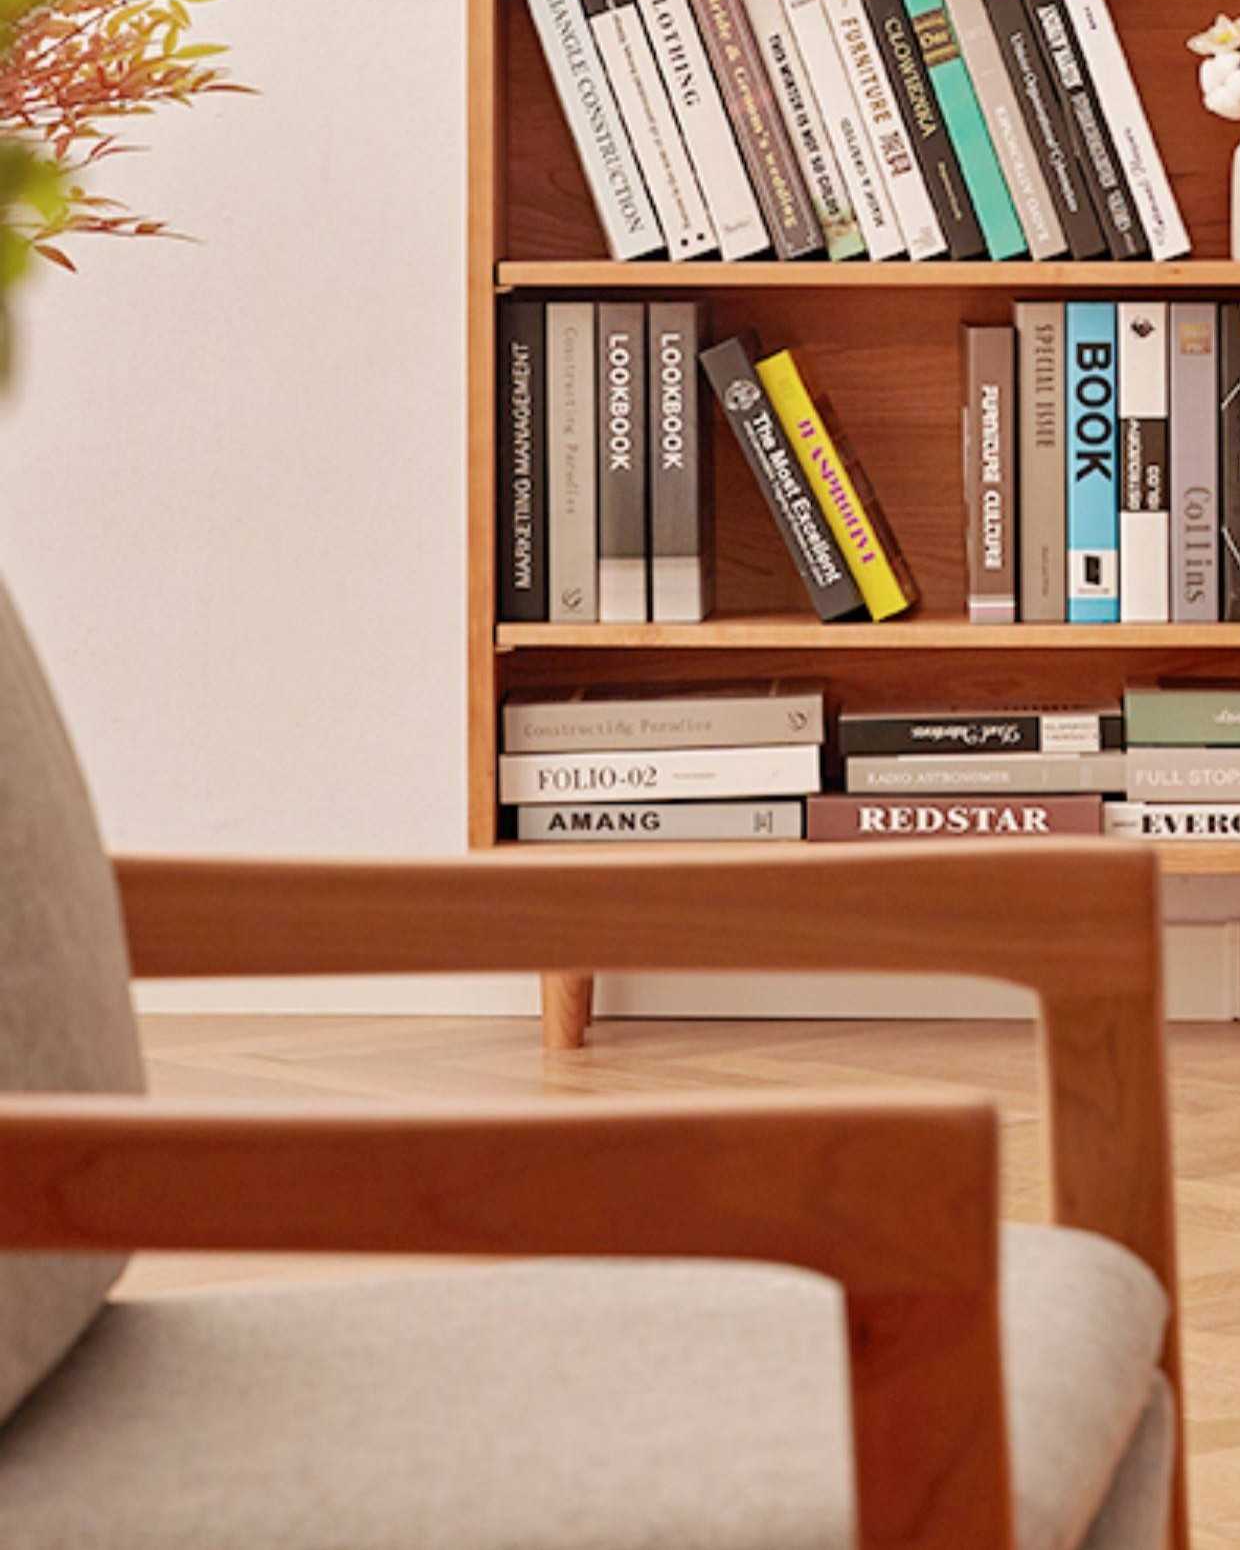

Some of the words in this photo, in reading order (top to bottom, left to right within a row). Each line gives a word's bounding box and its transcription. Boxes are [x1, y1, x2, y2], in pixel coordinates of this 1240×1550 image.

[723, 44, 741, 62] &
[840, 16, 890, 125] FURNITURE
[576, 77, 645, 235] CONSTRUCTION
[511, 341, 532, 476] MANAGEMENT
[609, 332, 631, 472] LOOKBOOK
[661, 332, 683, 471] LOOKBOOK
[1034, 324, 1056, 394] SPECIAL
[1075, 341, 1113, 483] BOOK
[1035, 402, 1056, 449] ISSUE
[513, 477, 532, 589] MARKETING
[752, 410, 774, 450] The
[770, 448, 799, 497] Most
[792, 499, 842, 586] Excellent
[1185, 486, 1211, 604] Collins
[537, 765, 658, 791] FOLIO-02
[548, 812, 661, 831] AMANG
[858, 806, 1049, 833] REDSTAR
[1136, 770, 1184, 786] FULL
